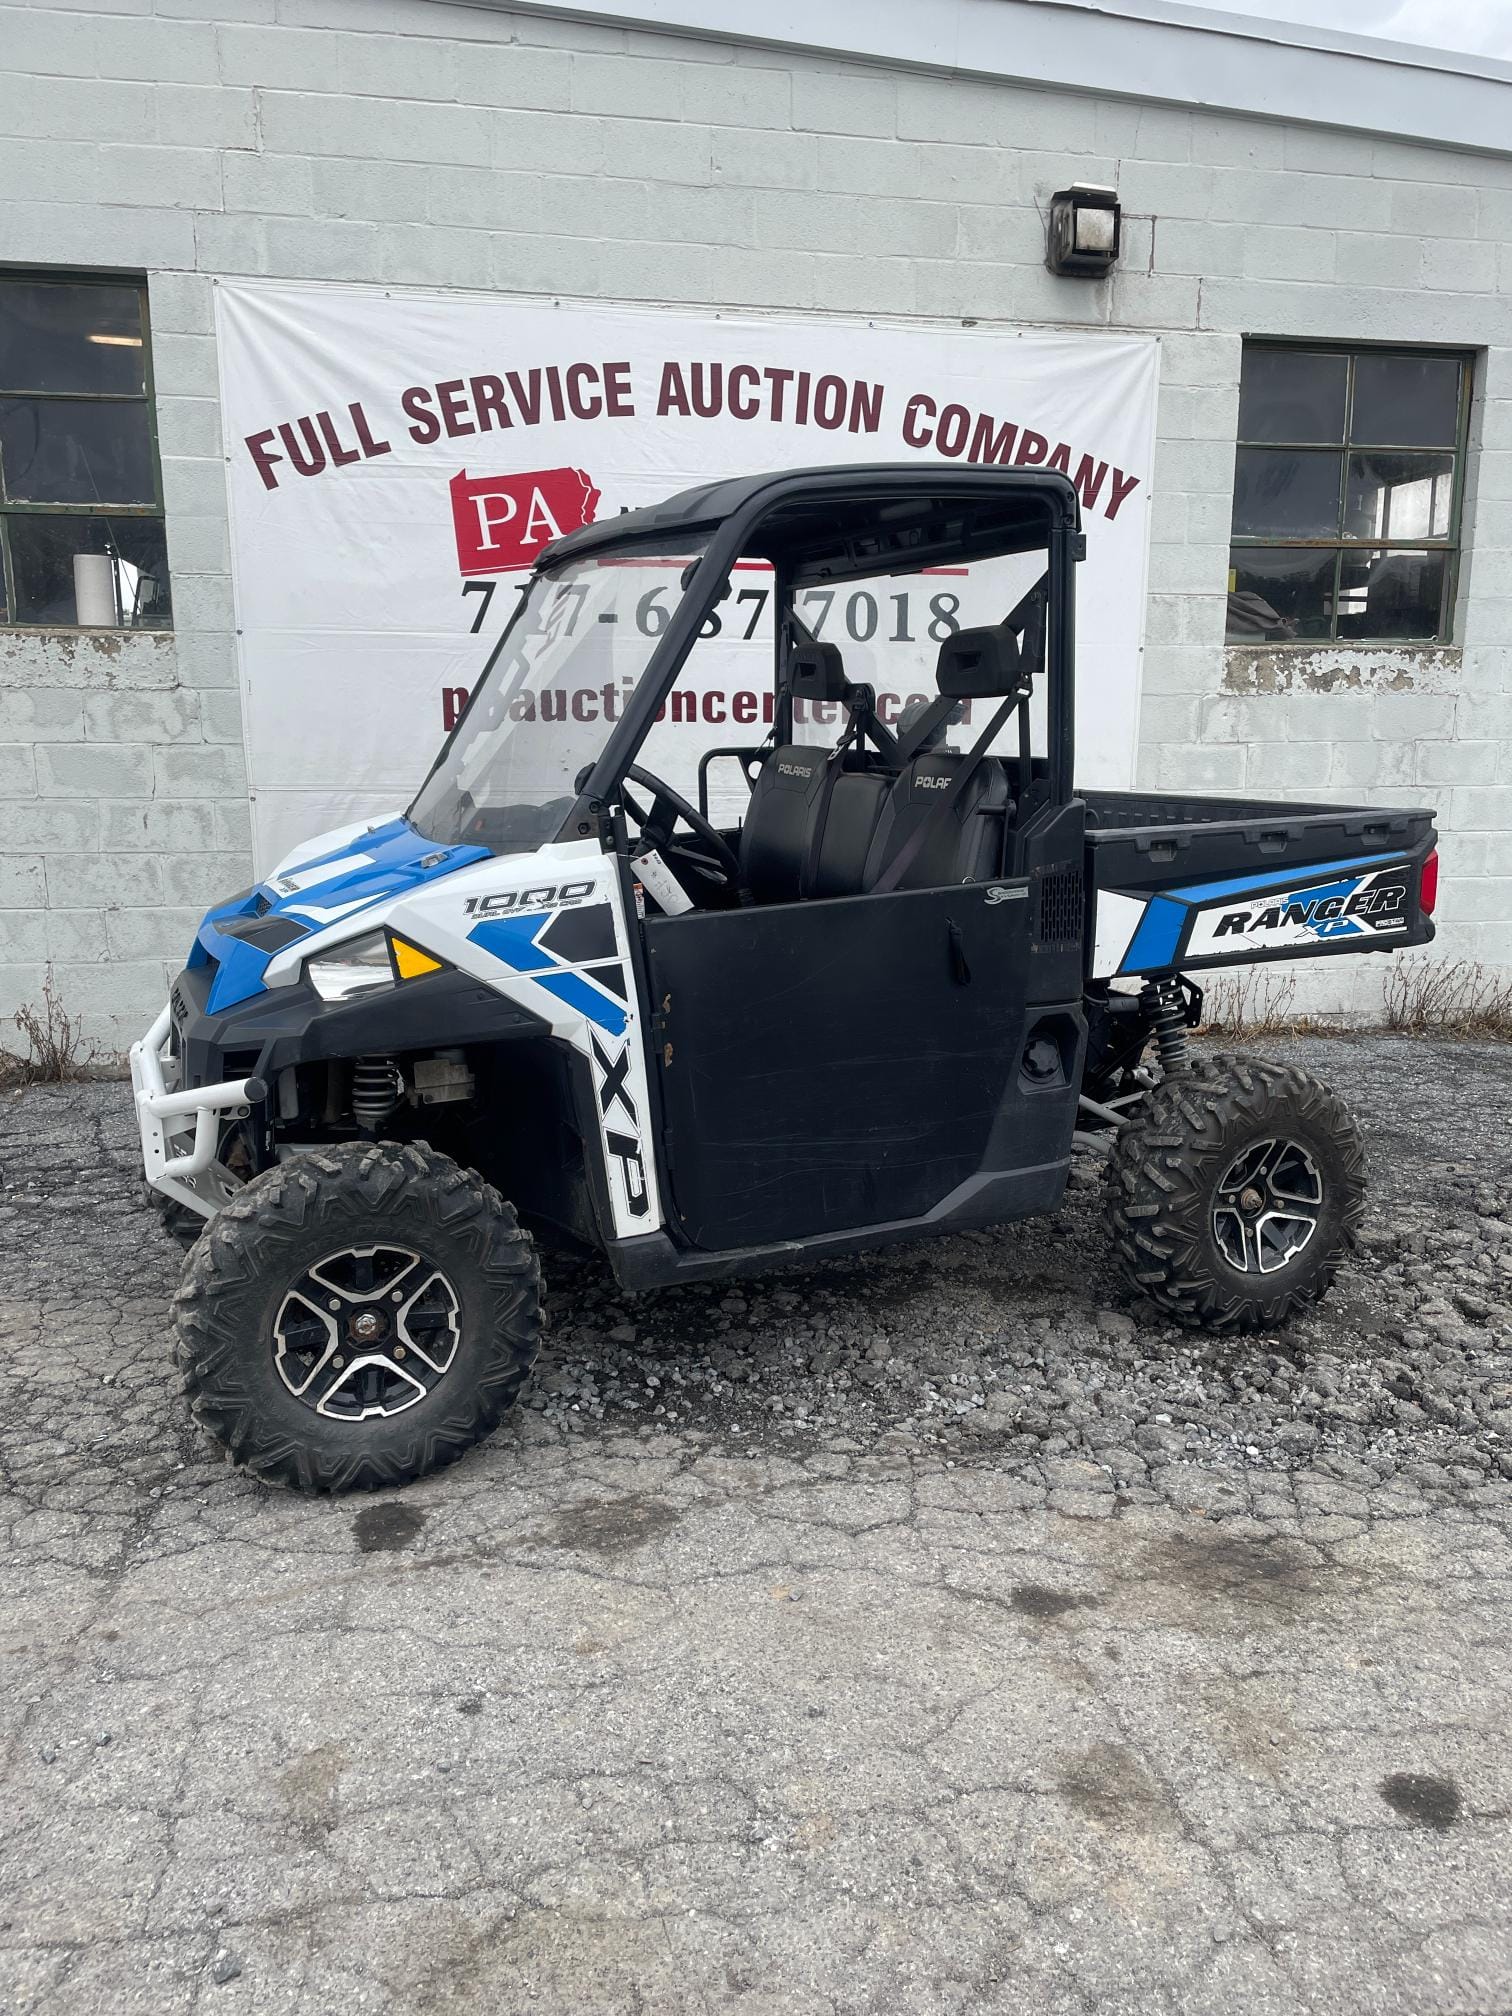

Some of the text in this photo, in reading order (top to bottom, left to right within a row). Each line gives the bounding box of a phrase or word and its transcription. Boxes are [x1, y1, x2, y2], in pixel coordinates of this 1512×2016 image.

[244, 361, 1141, 521] FULL SERVICE AUCTION COMPANY
[468, 486, 567, 550] PA
[778, 763, 812, 778] POLARIS
[464, 880, 596, 914] 1000
[1212, 886, 1406, 938] RANGER
[1251, 897, 1289, 910] POLARIS
[1294, 919, 1349, 939] XP
[588, 1022, 650, 1218] XP
